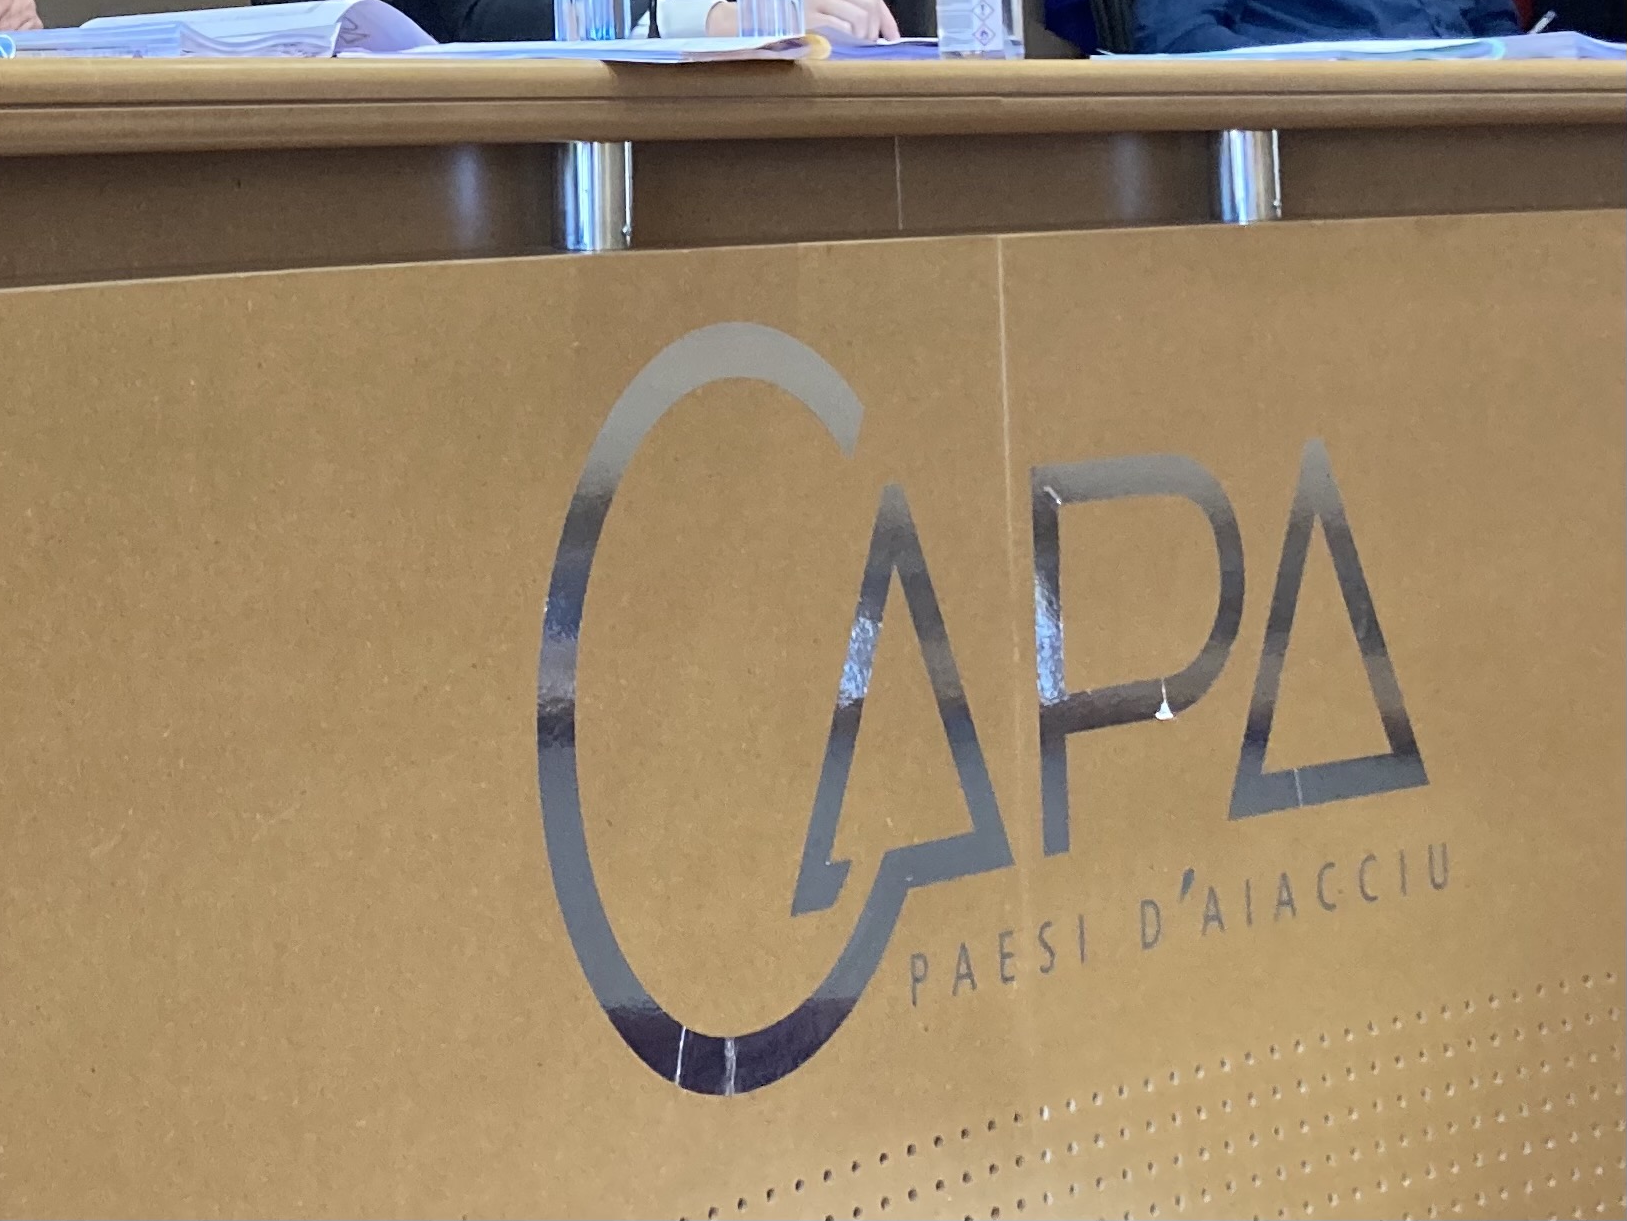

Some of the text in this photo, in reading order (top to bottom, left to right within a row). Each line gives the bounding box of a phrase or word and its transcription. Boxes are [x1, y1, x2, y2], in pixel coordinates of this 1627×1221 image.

[537, 321, 1430, 1096] CAPA
[909, 842, 1450, 1008] PAESI D'AIACCIU
